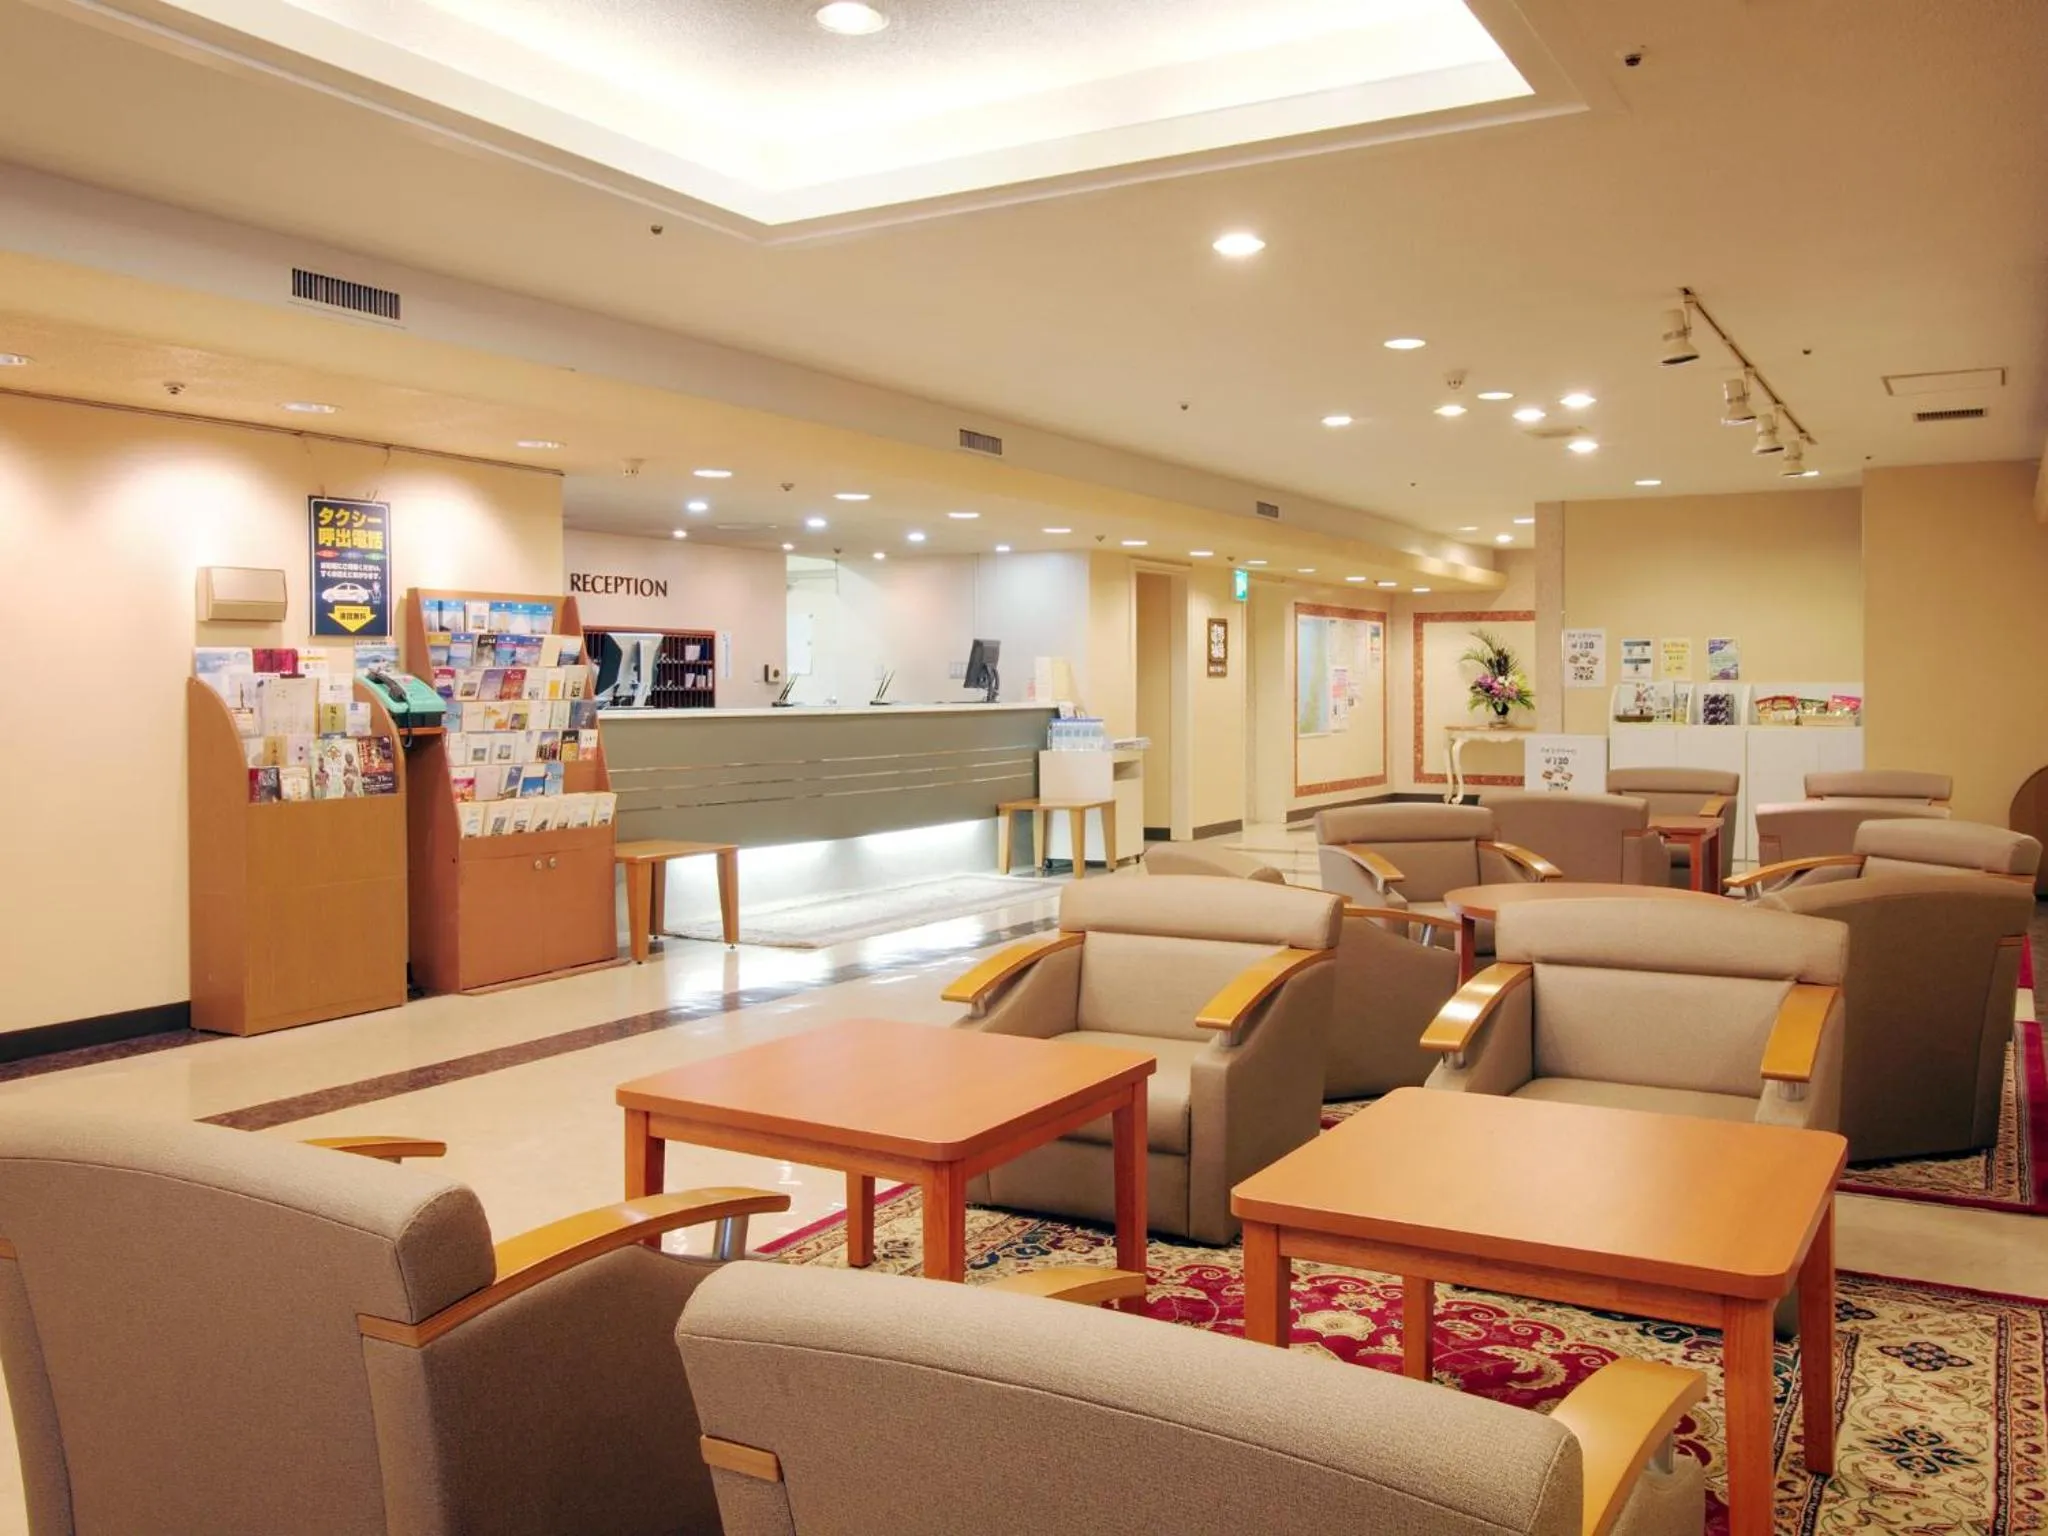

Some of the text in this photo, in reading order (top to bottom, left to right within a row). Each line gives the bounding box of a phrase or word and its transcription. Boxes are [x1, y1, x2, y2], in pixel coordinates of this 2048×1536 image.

[318, 507, 382, 527] タクシー
[570, 573, 668, 598] RECEPTION
